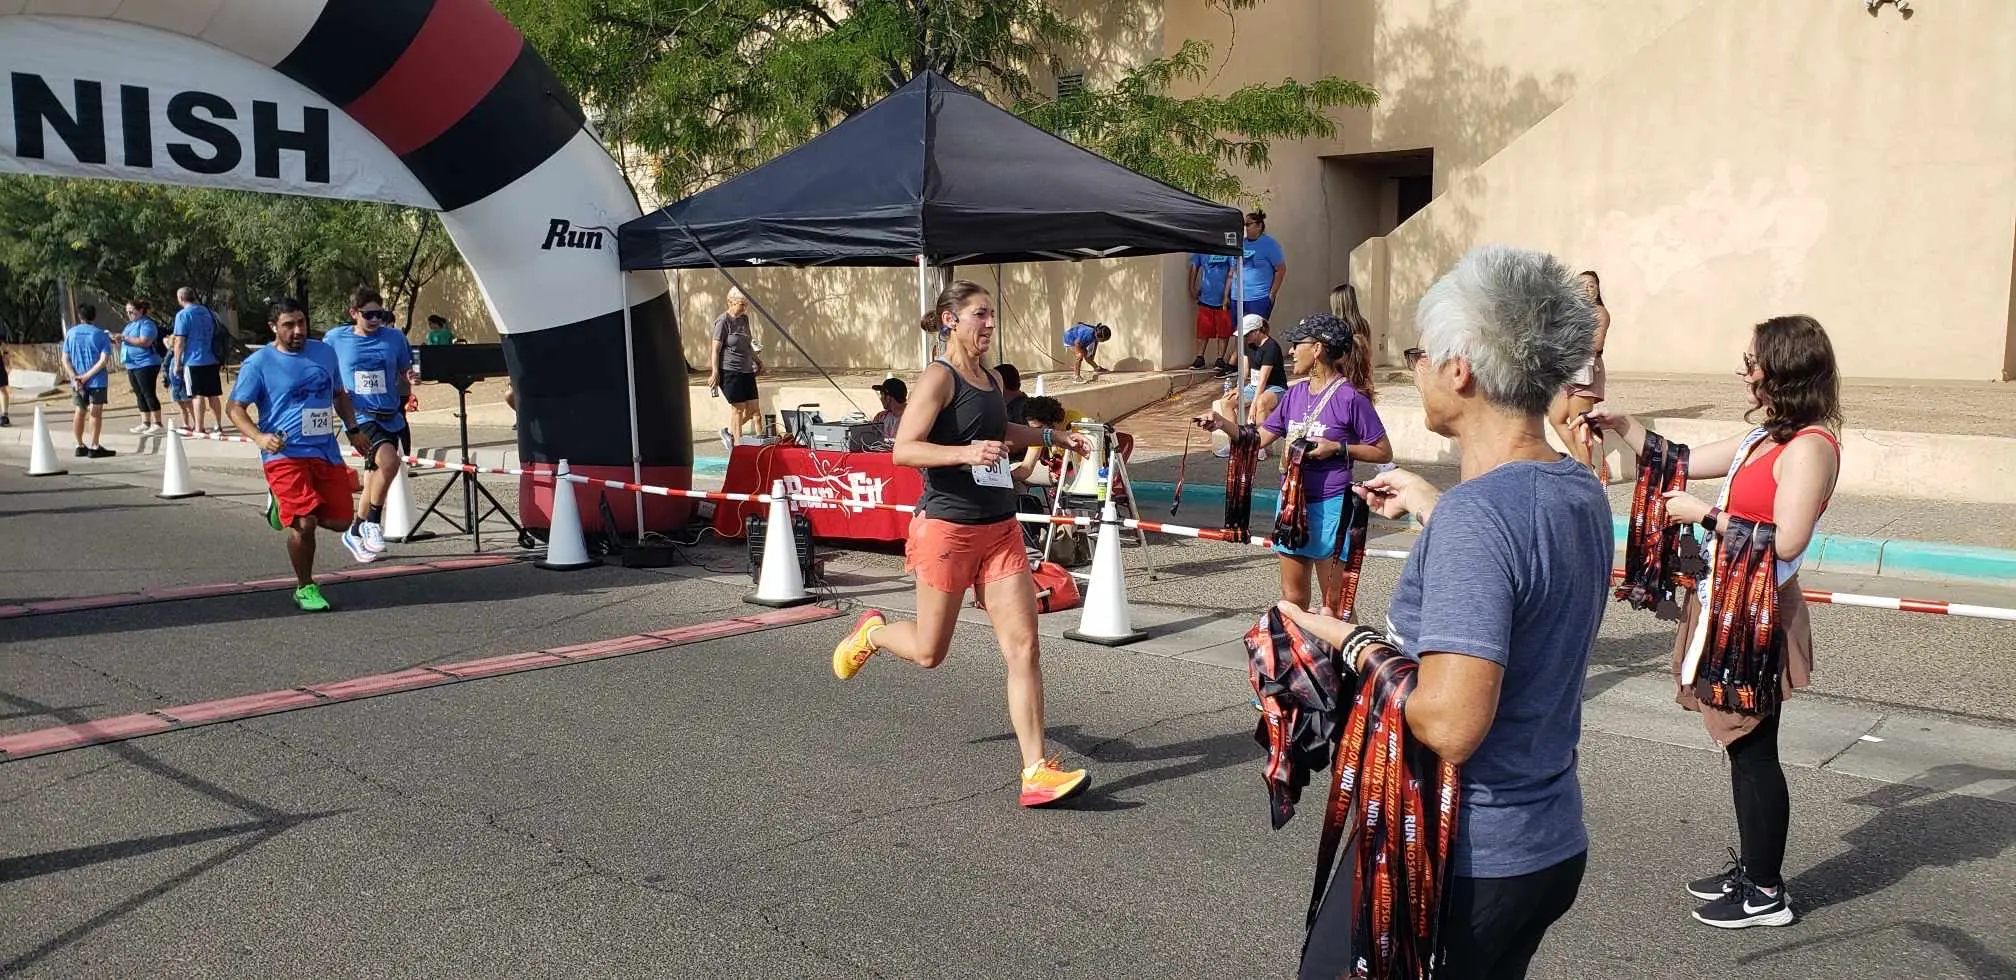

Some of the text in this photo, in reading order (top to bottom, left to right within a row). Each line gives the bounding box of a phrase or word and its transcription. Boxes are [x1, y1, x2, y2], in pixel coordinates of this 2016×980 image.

[11, 71, 330, 184] NISH
[541, 218, 603, 250] Run
[362, 380, 379, 388] 294
[312, 418, 328, 428] 124
[783, 472, 884, 513] Run Fit
